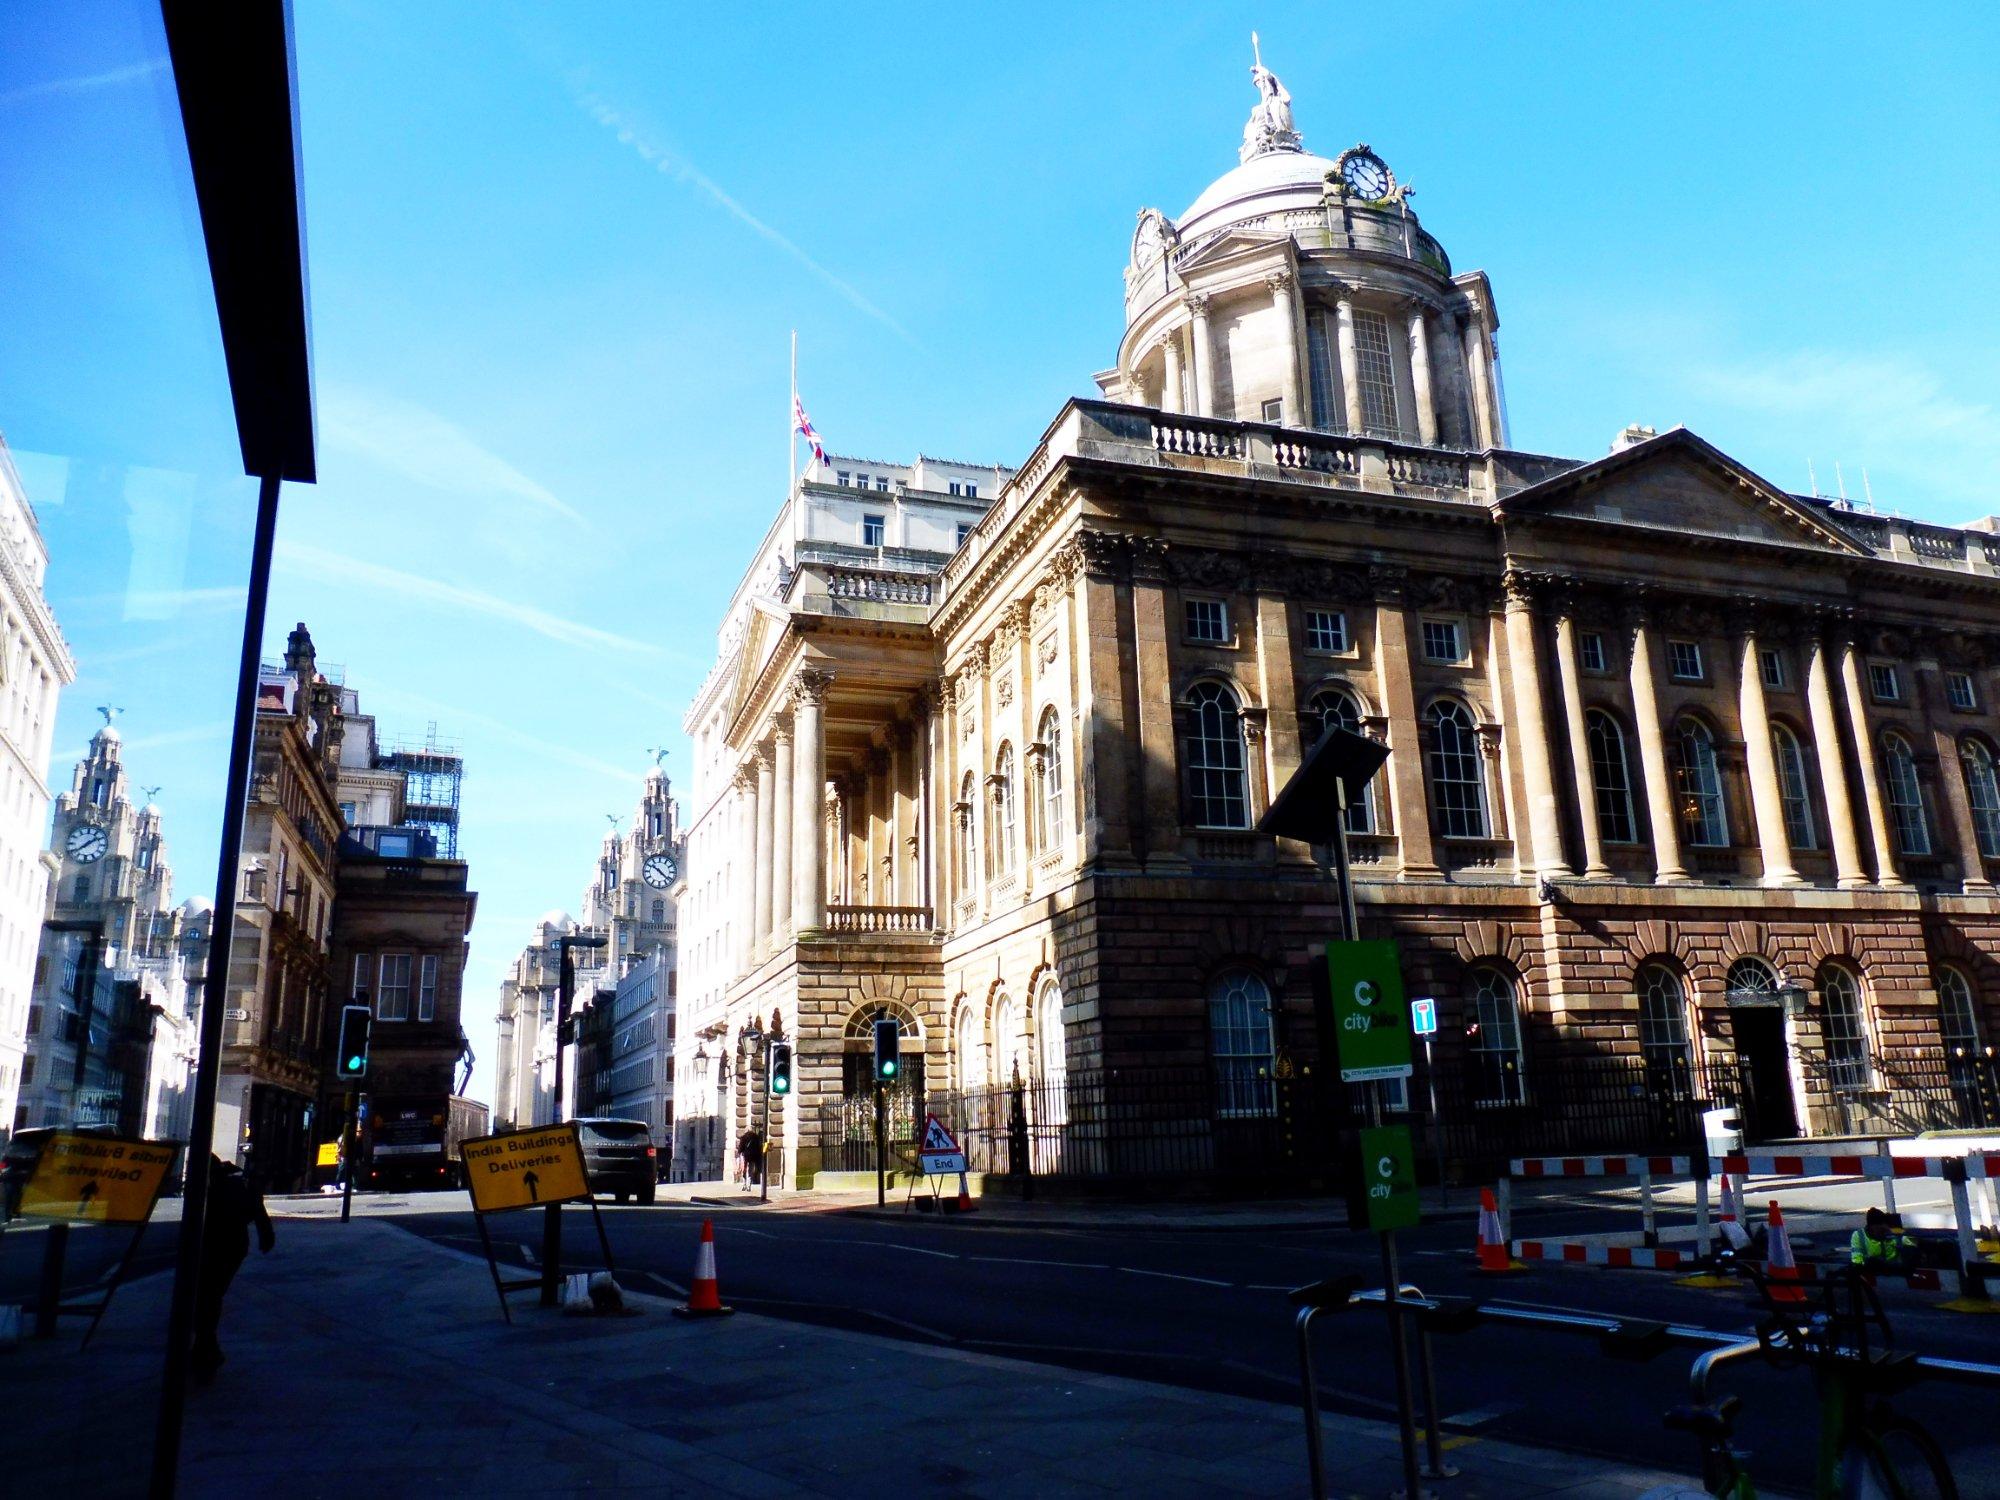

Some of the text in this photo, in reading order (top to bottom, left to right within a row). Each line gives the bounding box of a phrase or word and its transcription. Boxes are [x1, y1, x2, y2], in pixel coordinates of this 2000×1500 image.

[467, 1135, 573, 1159] India Buildings
[489, 1154, 562, 1173] Deliveries
[934, 1158, 954, 1168] End
